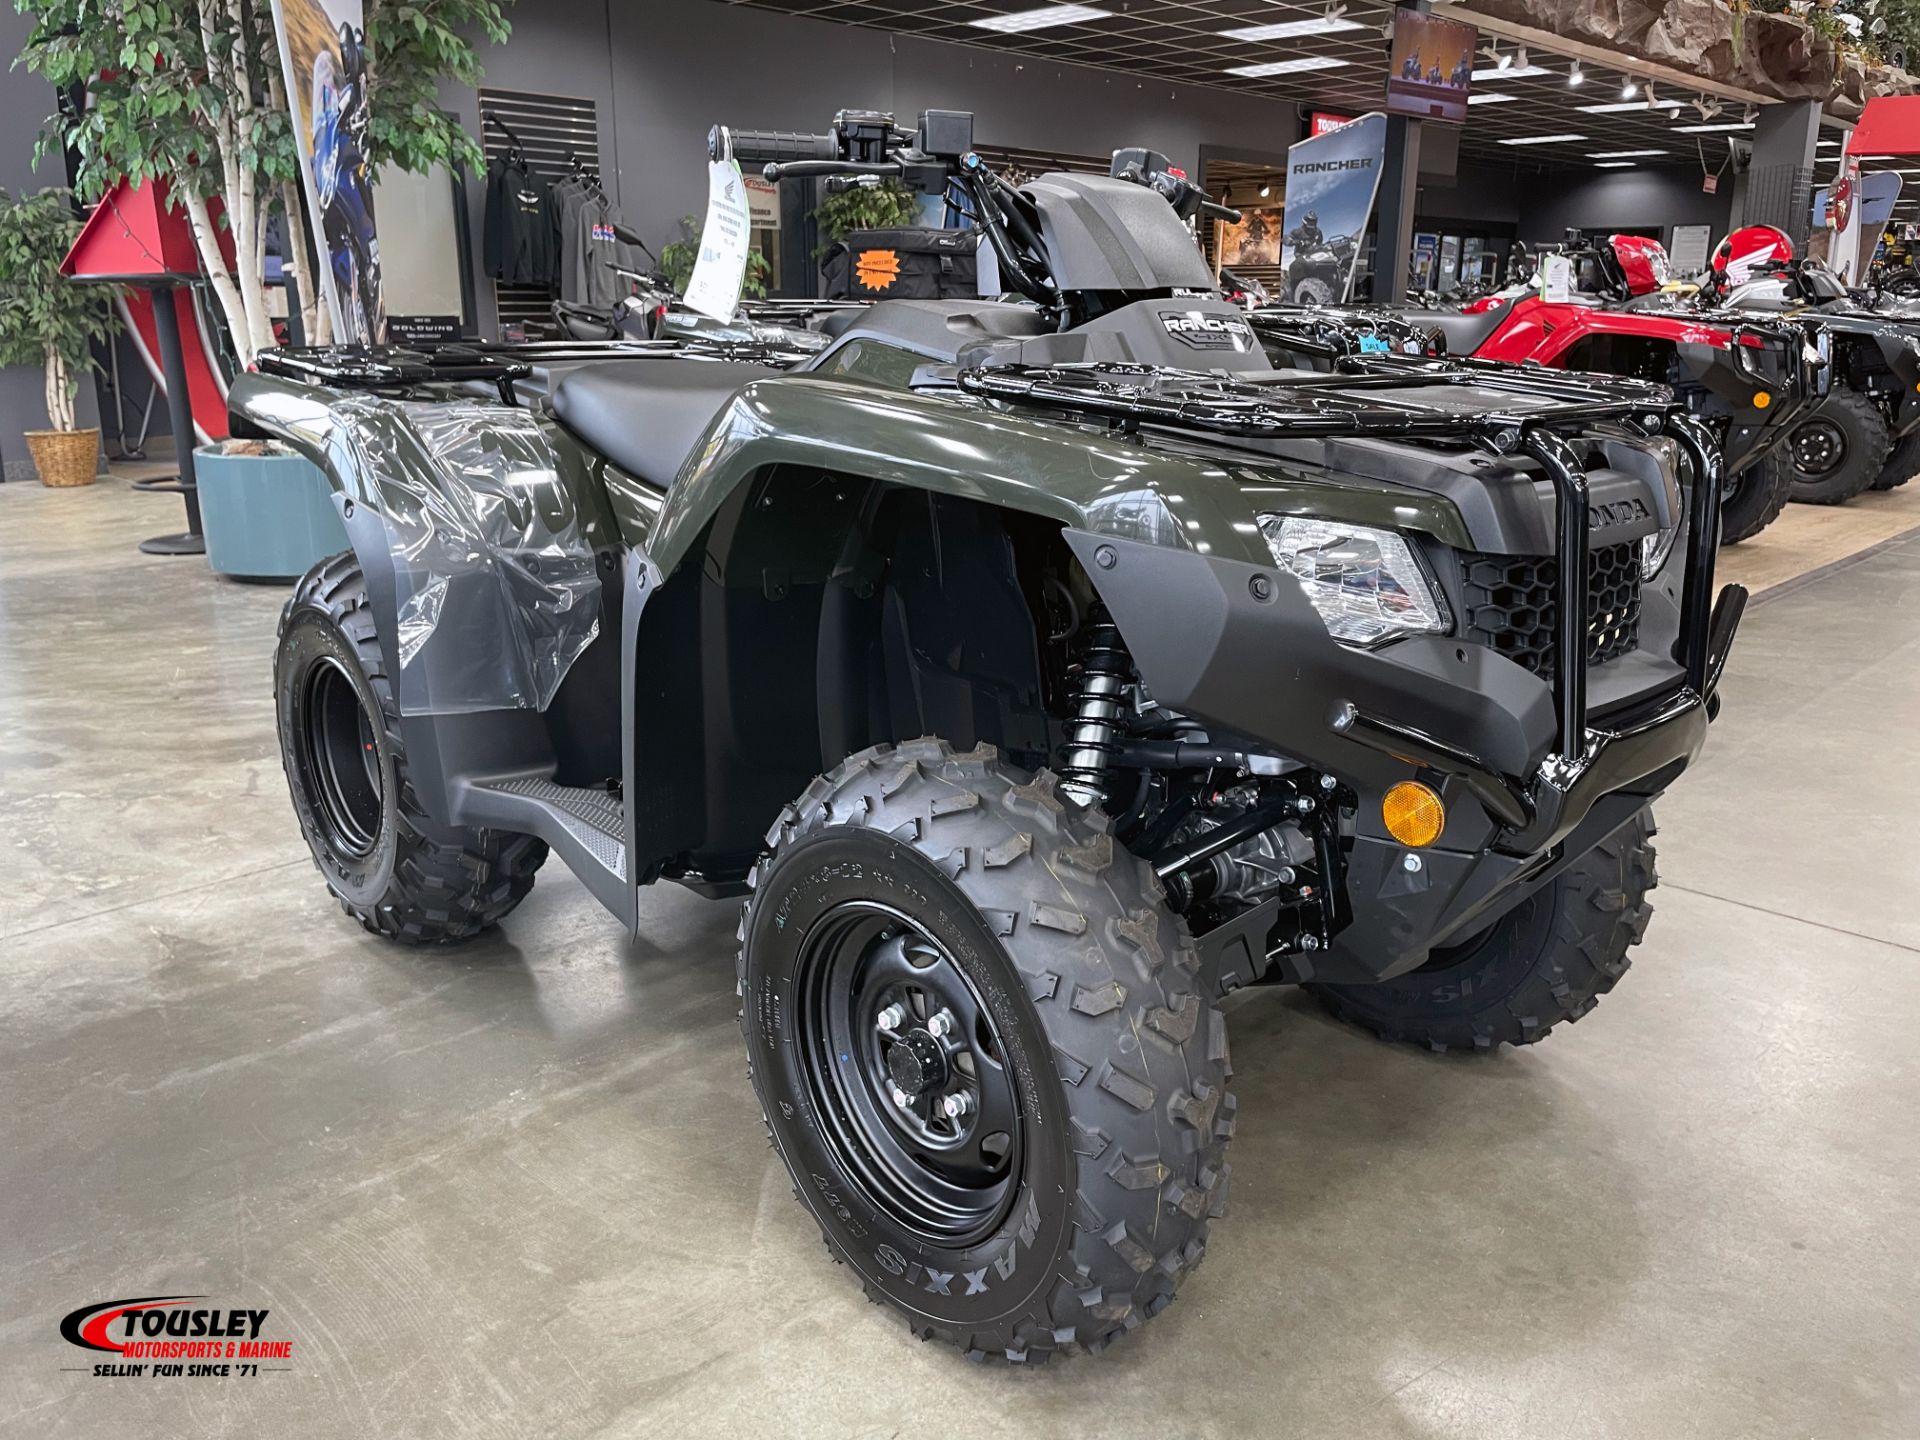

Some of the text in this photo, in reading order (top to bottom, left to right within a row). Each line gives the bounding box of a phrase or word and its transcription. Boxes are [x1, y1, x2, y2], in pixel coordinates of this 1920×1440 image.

[1293, 158, 1374, 175] RANCHER
[1163, 319, 1251, 335] RANCHER
[1589, 498, 1652, 531] ONDA
[873, 1187, 1041, 1297] MAXXIS
